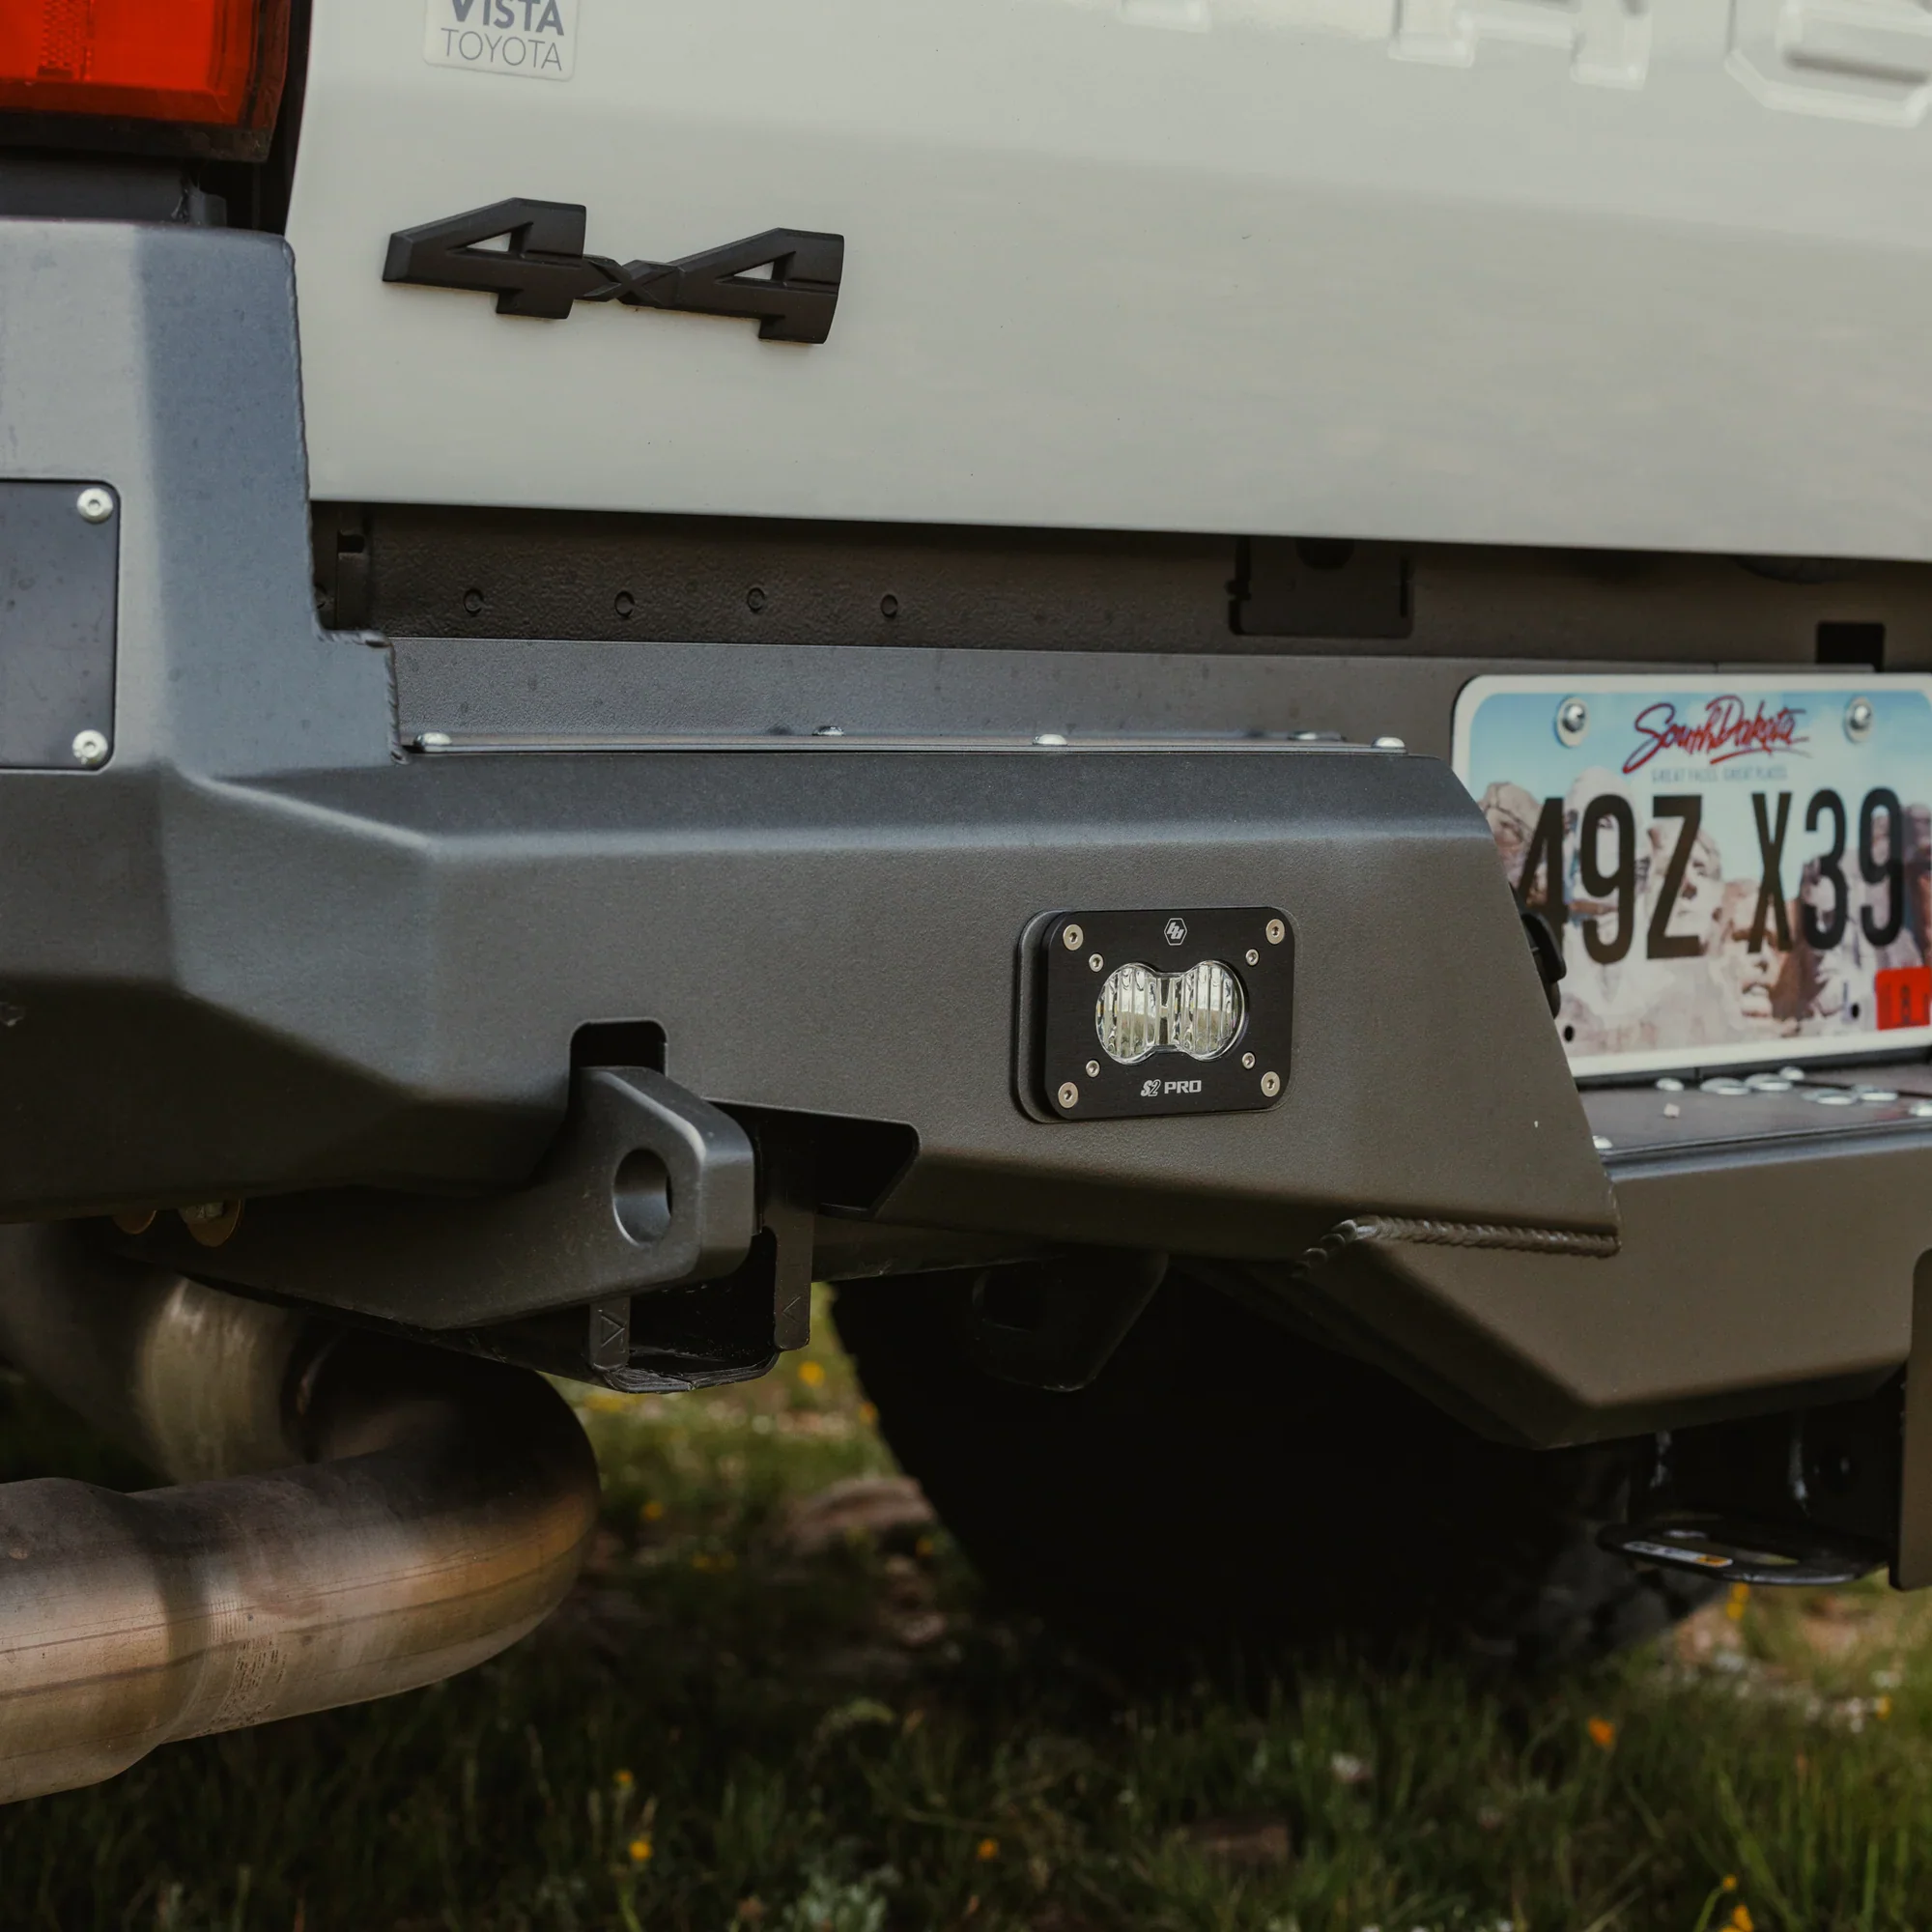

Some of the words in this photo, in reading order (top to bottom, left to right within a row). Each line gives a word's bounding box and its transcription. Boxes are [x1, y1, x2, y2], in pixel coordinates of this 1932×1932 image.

[452, 0, 565, 36] VISTA
[440, 27, 562, 71] TOYOTA
[1164, 1080, 1202, 1094] PRO
